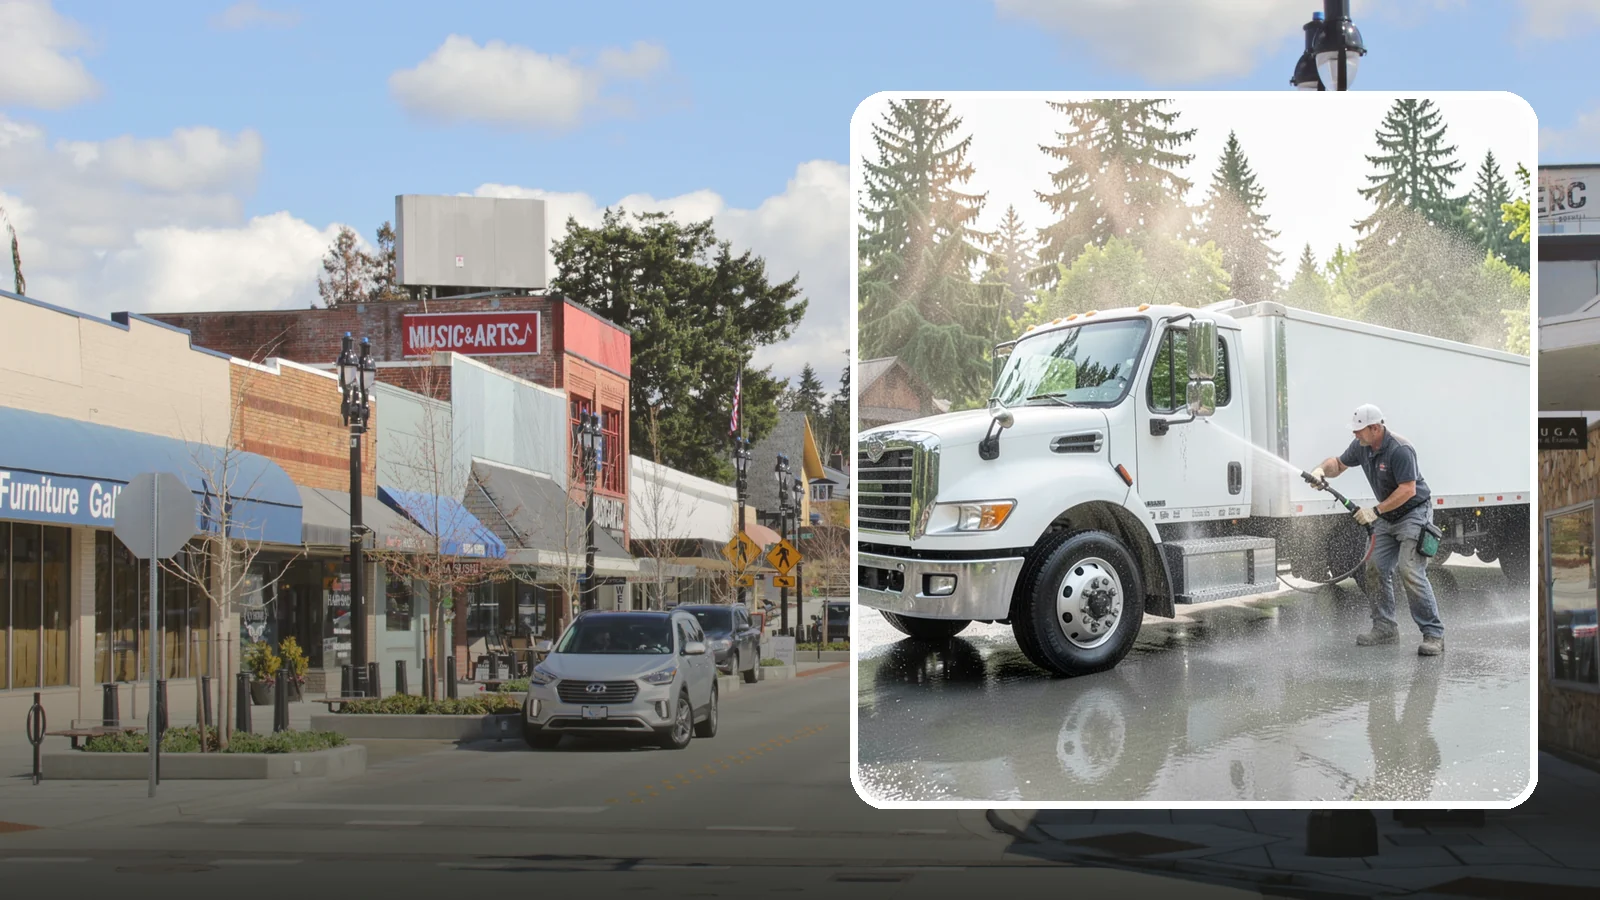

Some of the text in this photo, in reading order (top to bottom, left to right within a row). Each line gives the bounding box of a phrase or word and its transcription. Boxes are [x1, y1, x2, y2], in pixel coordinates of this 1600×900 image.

[408, 322, 519, 349] MUSIC&ARTS
[1540, 427, 1578, 437] UGA
[0, 471, 121, 519] Furniture Gal
